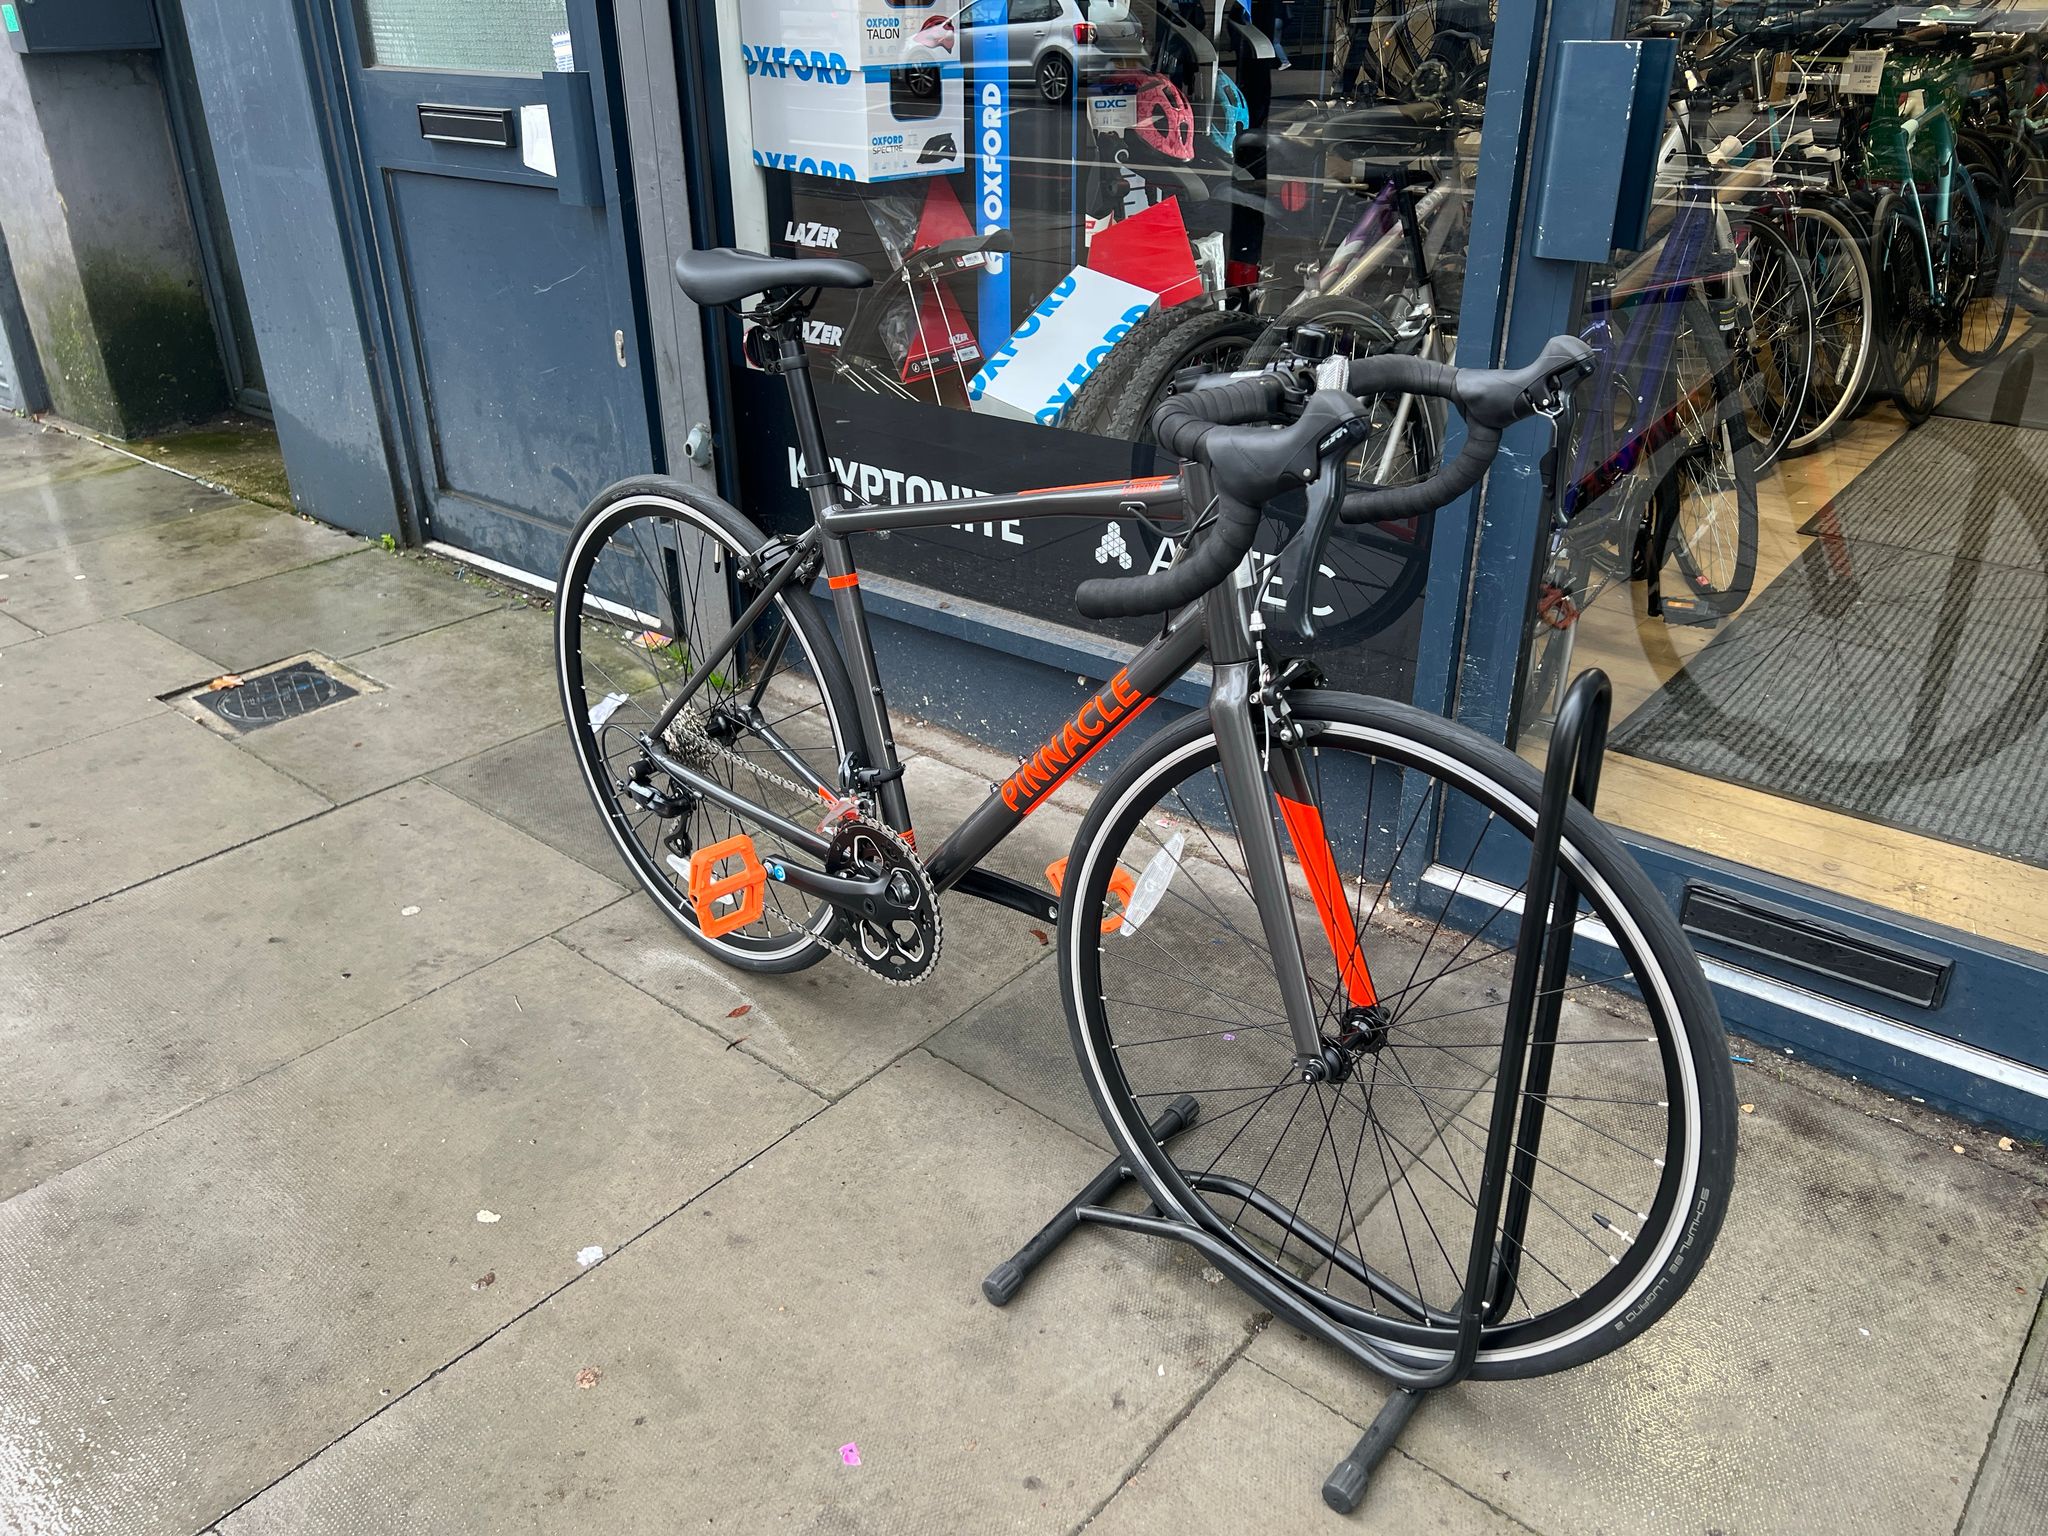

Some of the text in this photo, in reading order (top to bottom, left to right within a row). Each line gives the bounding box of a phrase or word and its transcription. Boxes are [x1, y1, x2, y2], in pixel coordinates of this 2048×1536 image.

[866, 17, 900, 28] OXFORD
[867, 28, 900, 40] TALON
[742, 44, 852, 85] OXFORD
[1095, 99, 1127, 109] OXC
[871, 135, 903, 146] OXFORD
[872, 145, 903, 155] SPECTRE
[982, 83, 1002, 220] OXFORD
[784, 221, 840, 250] LAZER
[802, 320, 843, 347] AZER
[787, 446, 1024, 545] KYPTONTE
[1001, 667, 1141, 812] PINNACLE
[1668, 1187, 1710, 1275] SCHWALBE
[1625, 1276, 1670, 1322] LUGANO
